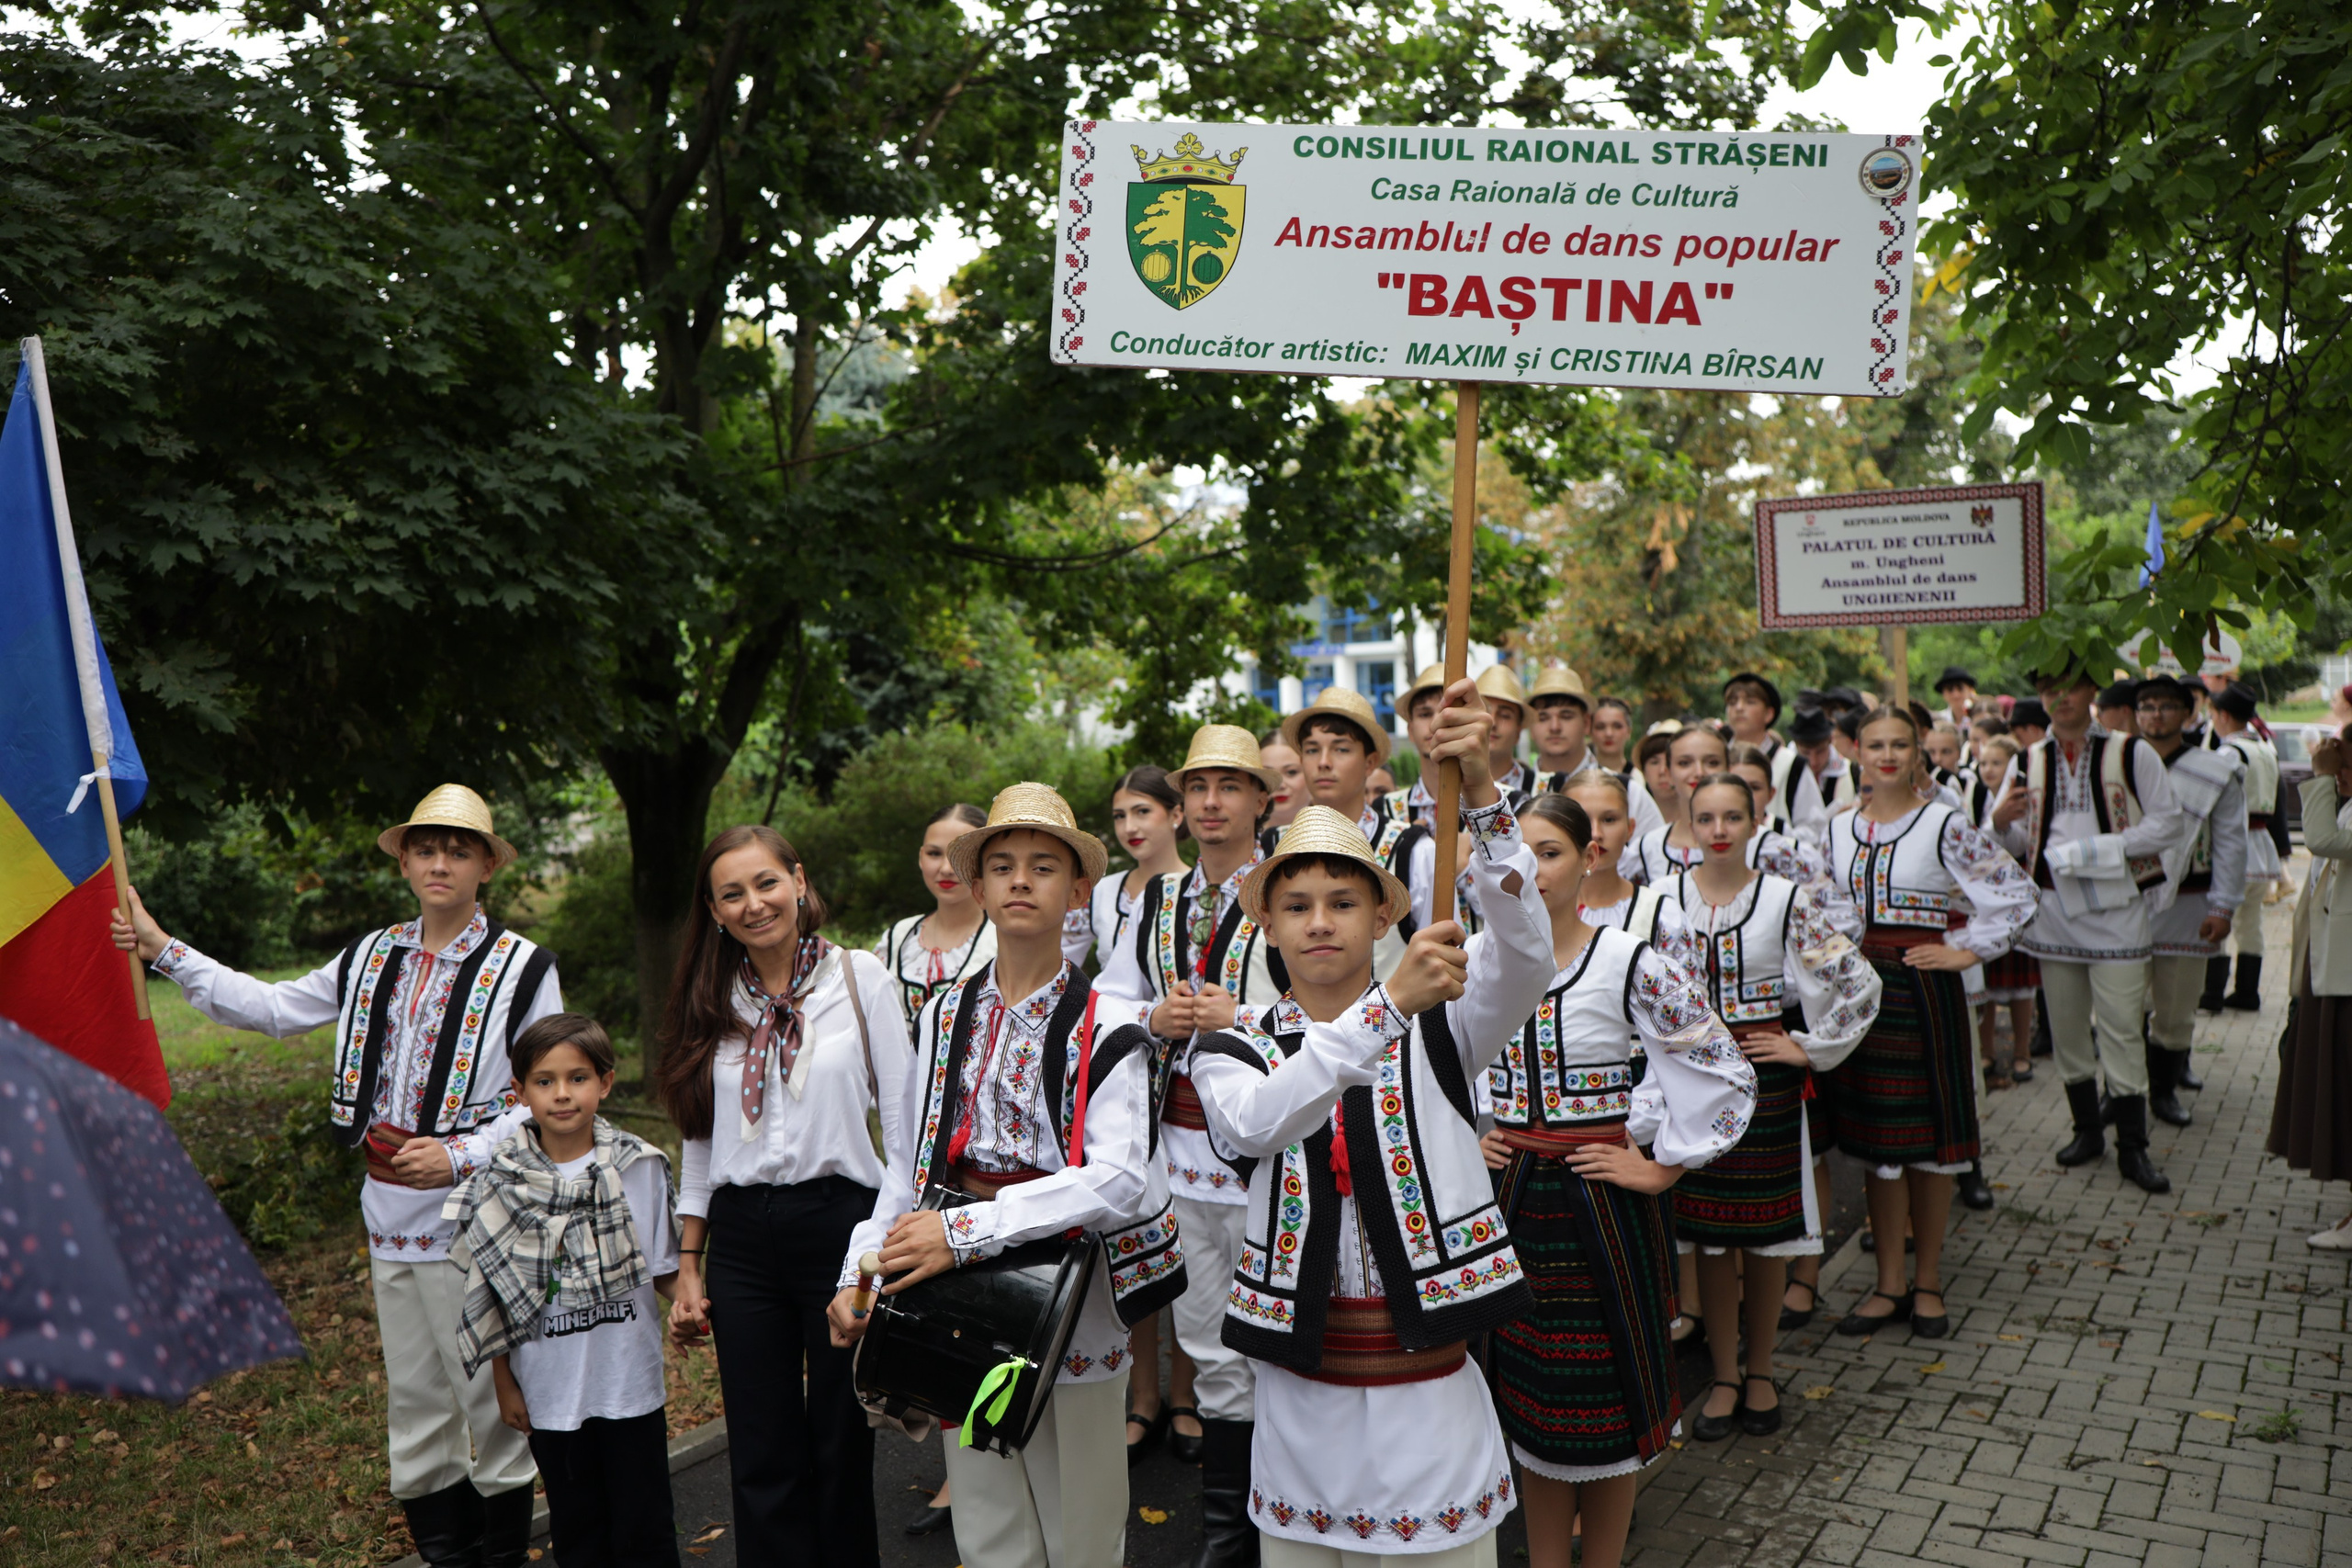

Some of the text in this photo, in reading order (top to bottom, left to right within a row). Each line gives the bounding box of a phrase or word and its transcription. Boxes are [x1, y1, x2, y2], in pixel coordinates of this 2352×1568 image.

[1293, 135, 1828, 175] CONSILIUL RAIONAL STRĂȘENI
[1370, 177, 1739, 209] Casa Raională de Cultură
[1274, 217, 1840, 268] Ansamblul de dans popular
[1377, 272, 1734, 336] "BAȘTINA"
[1110, 330, 1825, 381] Conducător artistic: MAXIM și CRISTINA BÎRSAN
[1843, 513, 1951, 527] REPUBLICA MOLDOVA
[1803, 530, 1996, 554] PALATUL DE CULTURĂ
[1850, 553, 1945, 570] m. Ungheni
[1821, 570, 1977, 590] Ansamblul de dans
[1841, 589, 1957, 606] UNGHENENII
